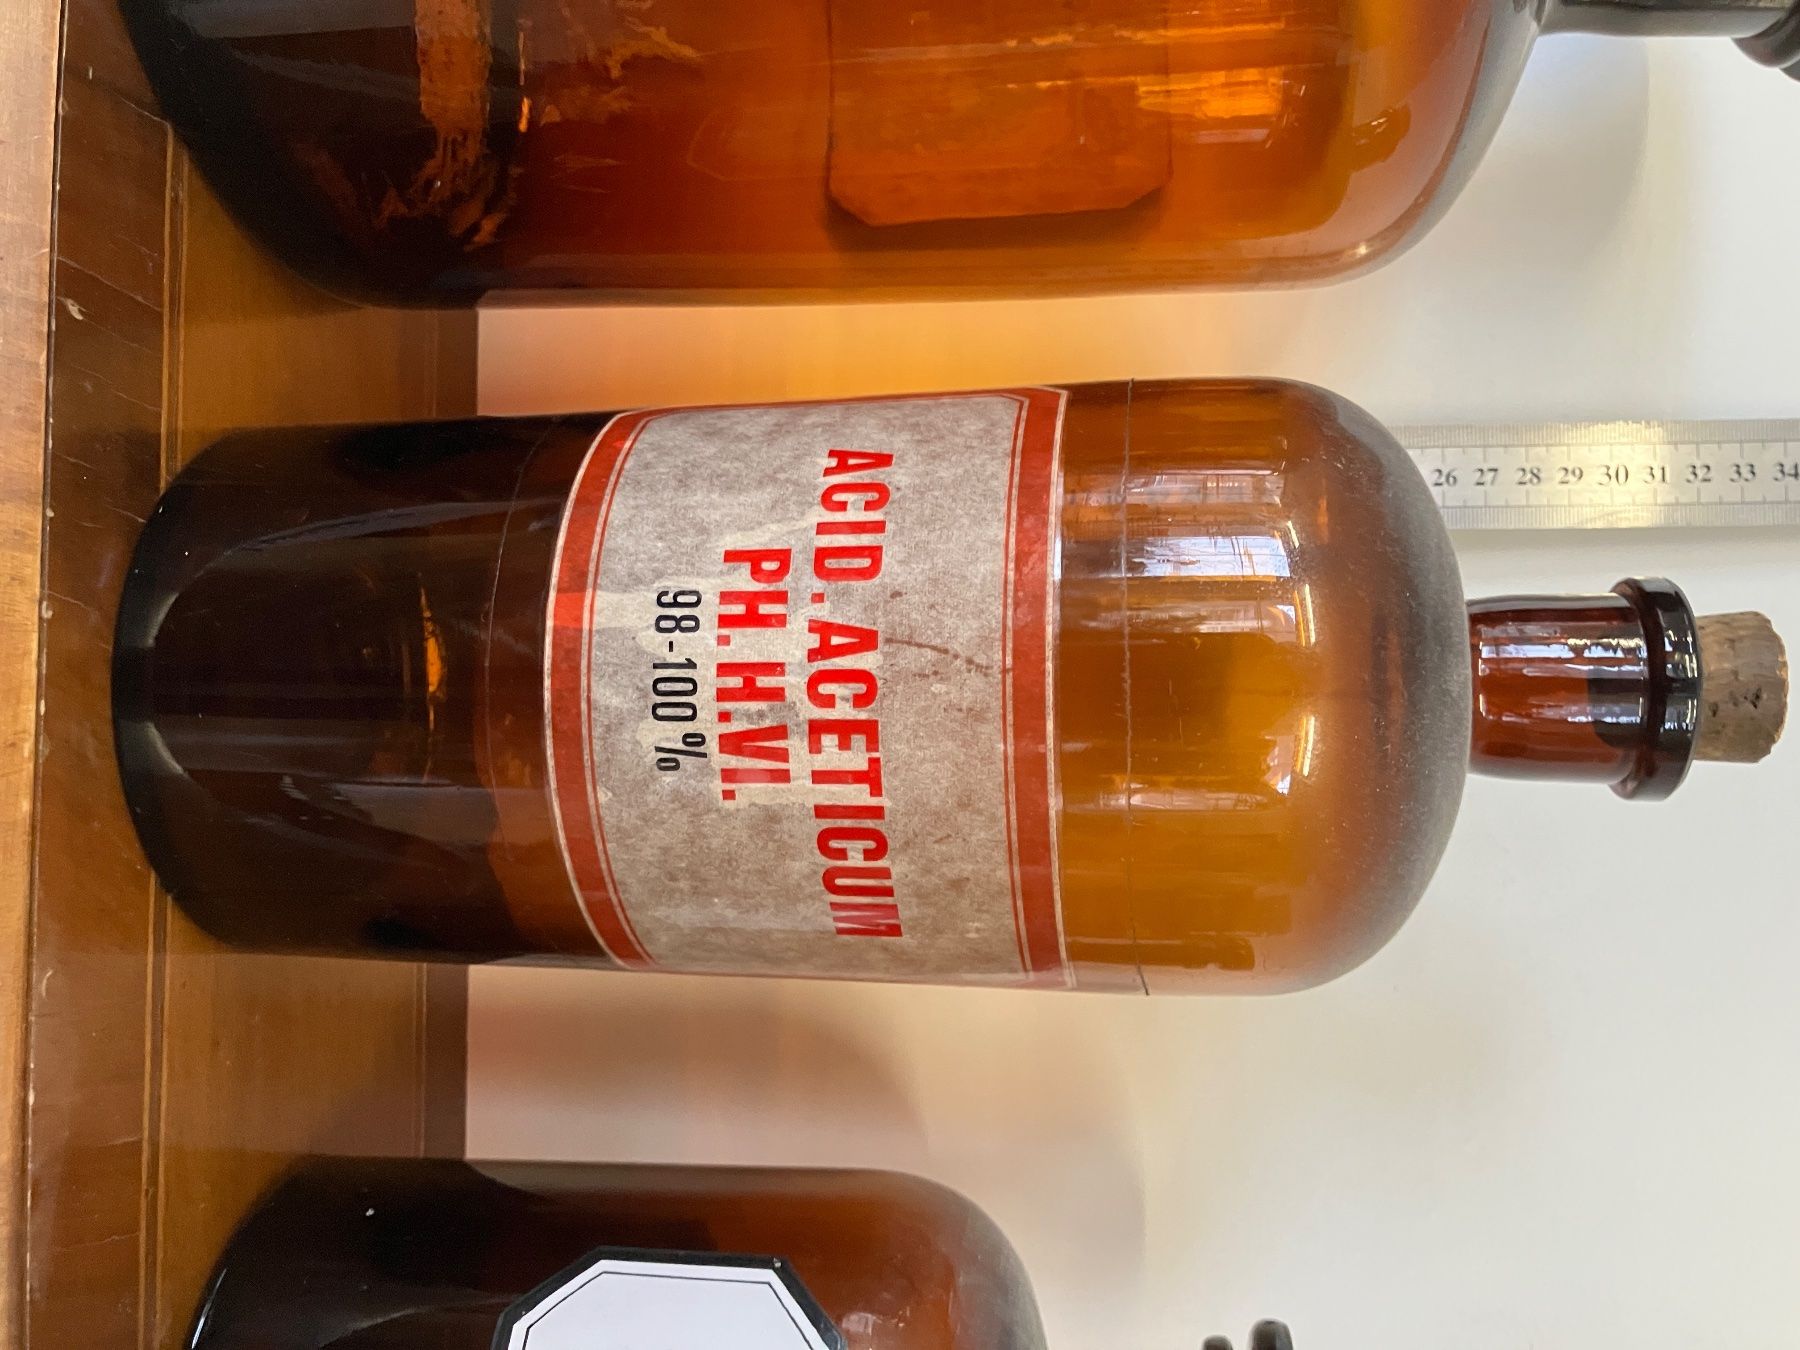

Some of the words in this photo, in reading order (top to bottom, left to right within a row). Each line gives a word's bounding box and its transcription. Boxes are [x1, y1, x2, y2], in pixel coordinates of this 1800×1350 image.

[811, 447, 896, 605] ACID.
[1432, 468, 1457, 488] 26
[1473, 468, 1498, 487] 27
[1515, 467, 1541, 486] 28
[1558, 466, 1583, 485] 29
[1599, 464, 1629, 487] 30
[1646, 465, 1669, 485] 31
[1685, 464, 1712, 484] 32
[1729, 463, 1757, 483] 33
[1773, 462, 1800, 482] 34
[716, 546, 793, 647] PH.
[715, 660, 792, 802] H.VI.
[805, 617, 904, 939] ACETICUM
